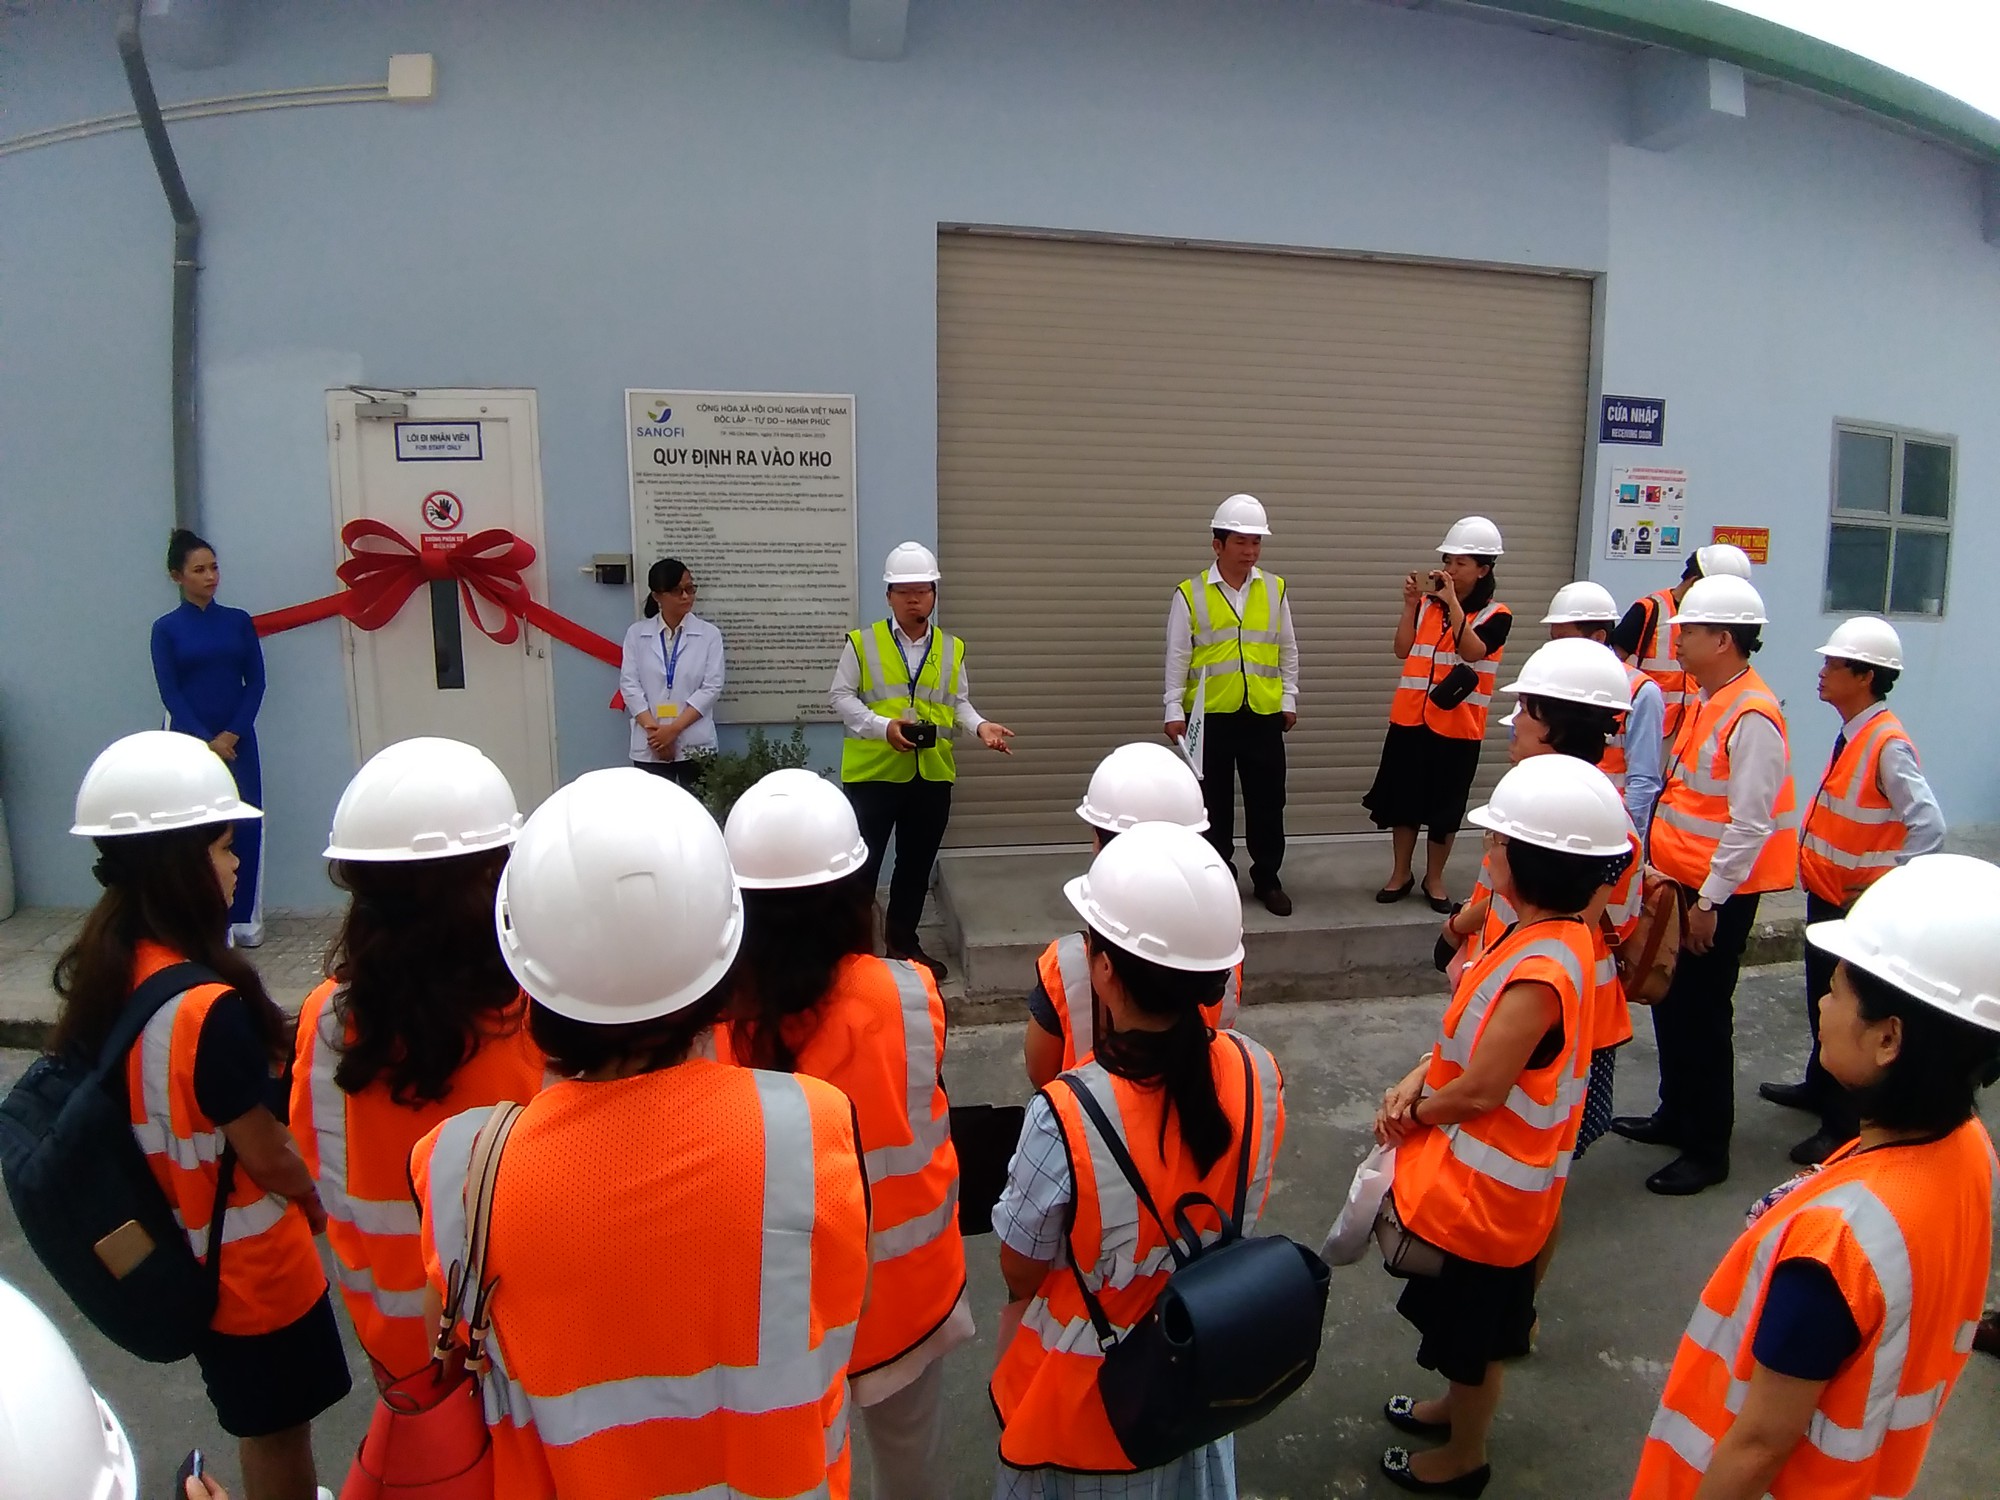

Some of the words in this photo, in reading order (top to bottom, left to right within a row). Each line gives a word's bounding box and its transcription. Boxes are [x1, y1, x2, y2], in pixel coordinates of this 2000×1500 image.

[696, 403, 719, 413] CỘNG
[740, 404, 750, 412] XÃ
[828, 407, 847, 415] NAM
[1607, 401, 1628, 422] CỬA
[1630, 406, 1659, 427] NHẬP
[636, 426, 684, 438] SANOFI
[653, 448, 688, 466] QUY
[692, 448, 732, 468] ĐỊNH
[736, 449, 758, 466] RA
[761, 446, 795, 466] VÀO
[800, 450, 832, 467] KHO
